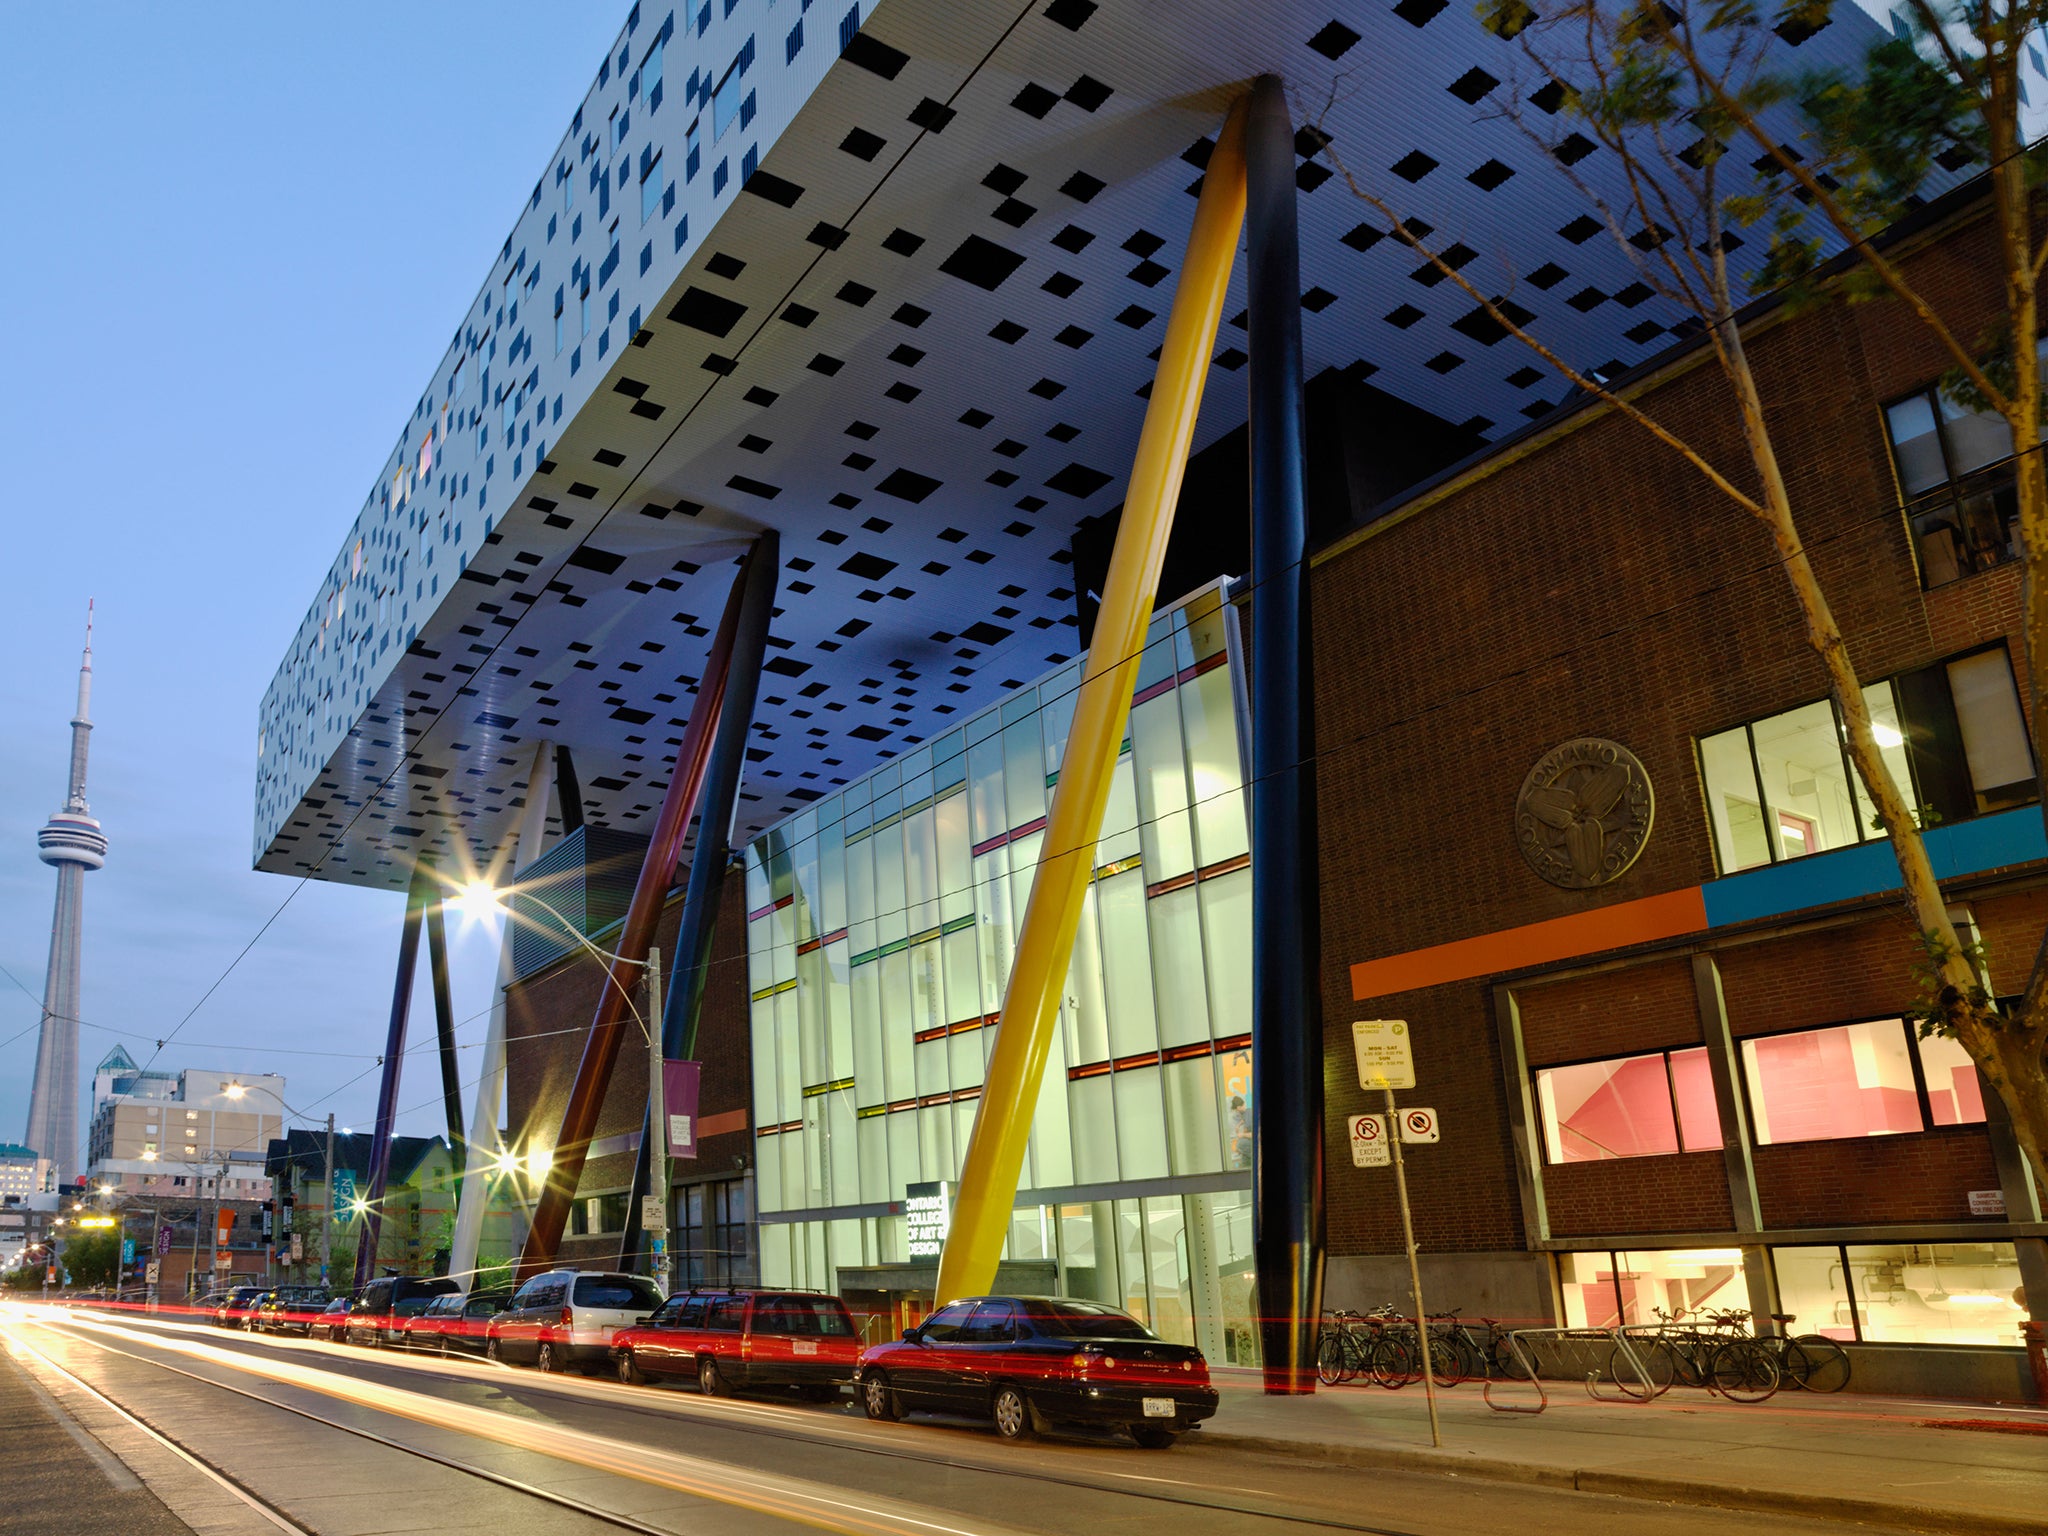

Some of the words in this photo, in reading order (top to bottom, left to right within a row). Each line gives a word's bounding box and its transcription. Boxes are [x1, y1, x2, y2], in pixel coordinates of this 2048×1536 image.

[1531, 742, 1618, 787] ONTARIO
[906, 1197, 943, 1211] ONTARIO
[908, 1226, 919, 1240] OF
[919, 1226, 936, 1240] ART
[909, 1241, 940, 1255] DESIGN
